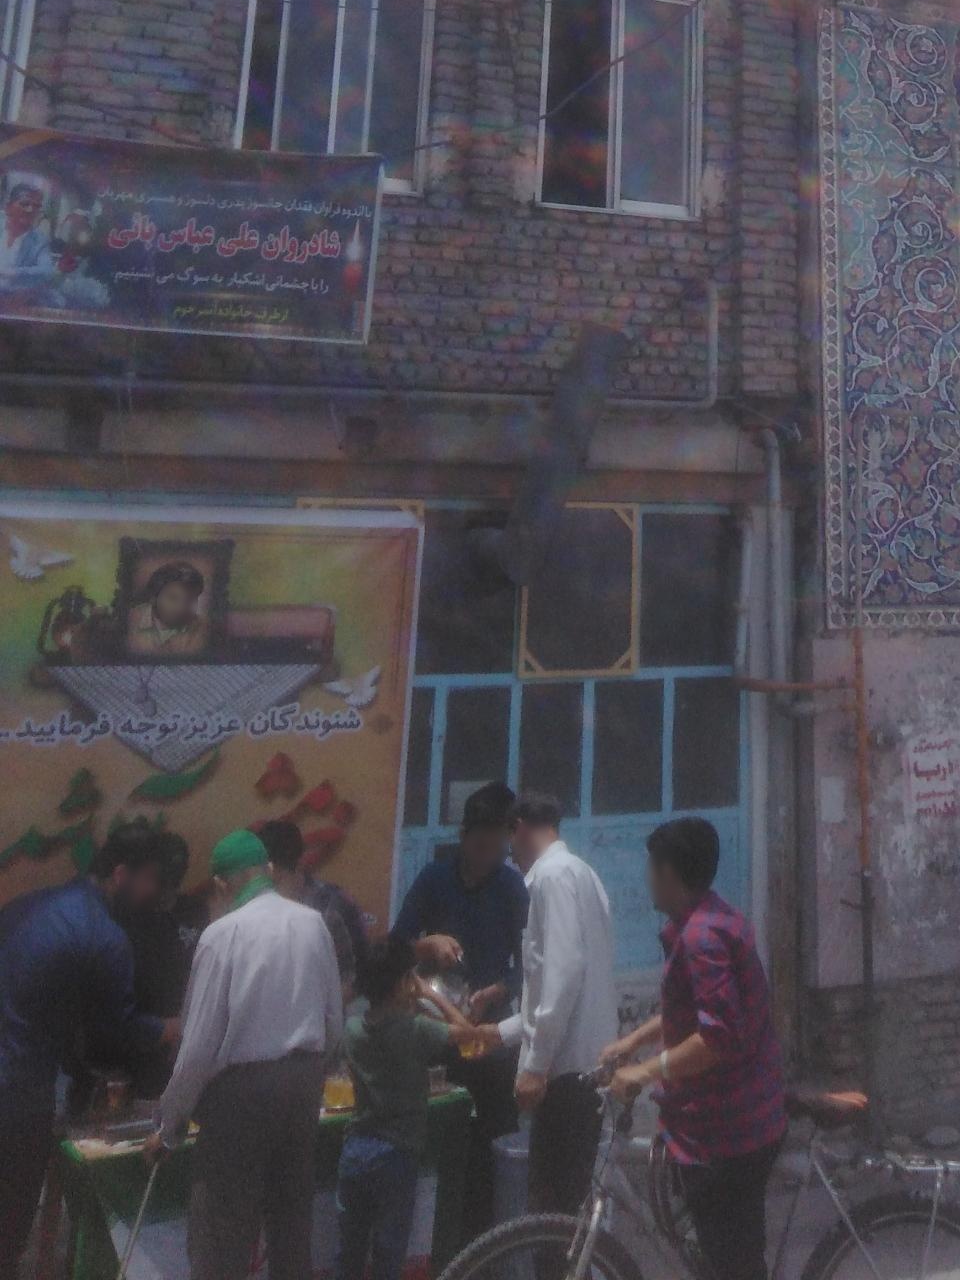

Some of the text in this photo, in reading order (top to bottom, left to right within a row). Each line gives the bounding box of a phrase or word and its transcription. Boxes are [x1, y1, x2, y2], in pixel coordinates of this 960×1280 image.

[158, 217, 216, 254] عباس
[216, 221, 260, 258] علی
[261, 224, 341, 264] شادروان
[155, 270, 175, 285] می
[176, 266, 210, 286] سوگ
[227, 272, 265, 287] اشکبار
[265, 275, 310, 293] چشمانی
[14, 712, 113, 744] فرمایید
[119, 713, 179, 742] توجه
[183, 712, 241, 741] عزیز
